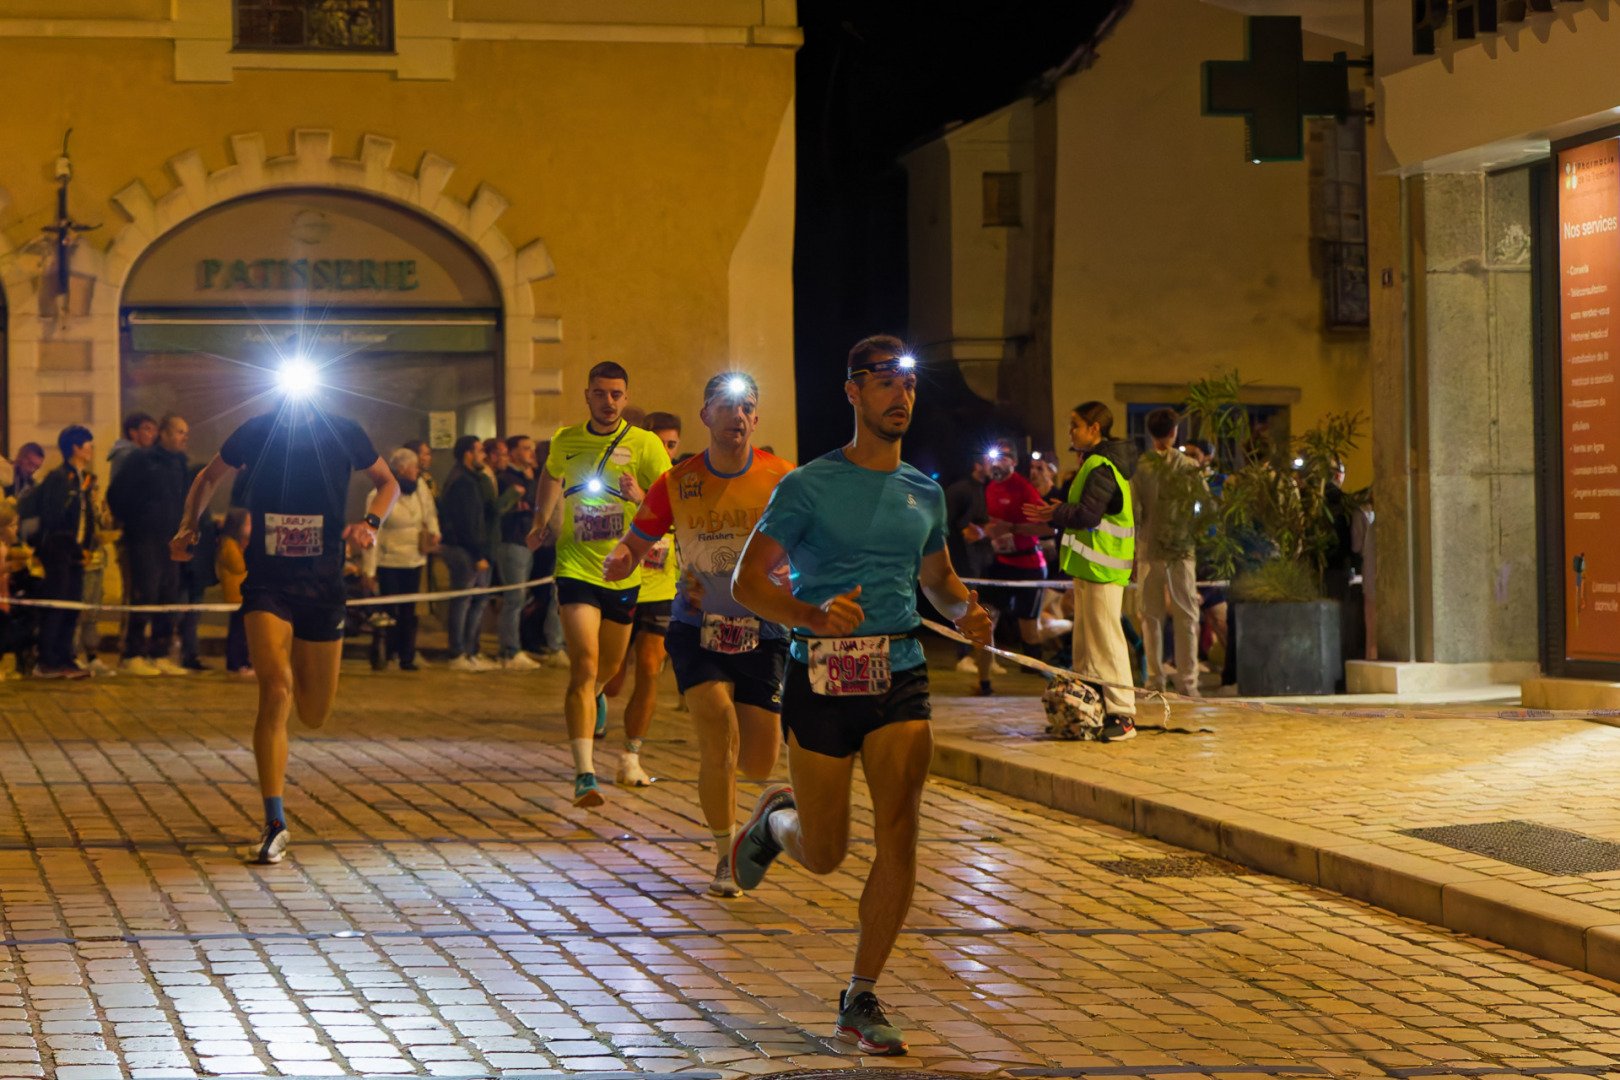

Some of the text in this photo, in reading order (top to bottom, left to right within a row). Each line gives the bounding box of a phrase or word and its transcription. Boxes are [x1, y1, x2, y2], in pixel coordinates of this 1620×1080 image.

[1563, 214, 1618, 240] Nos services
[826, 653, 871, 682] 692
